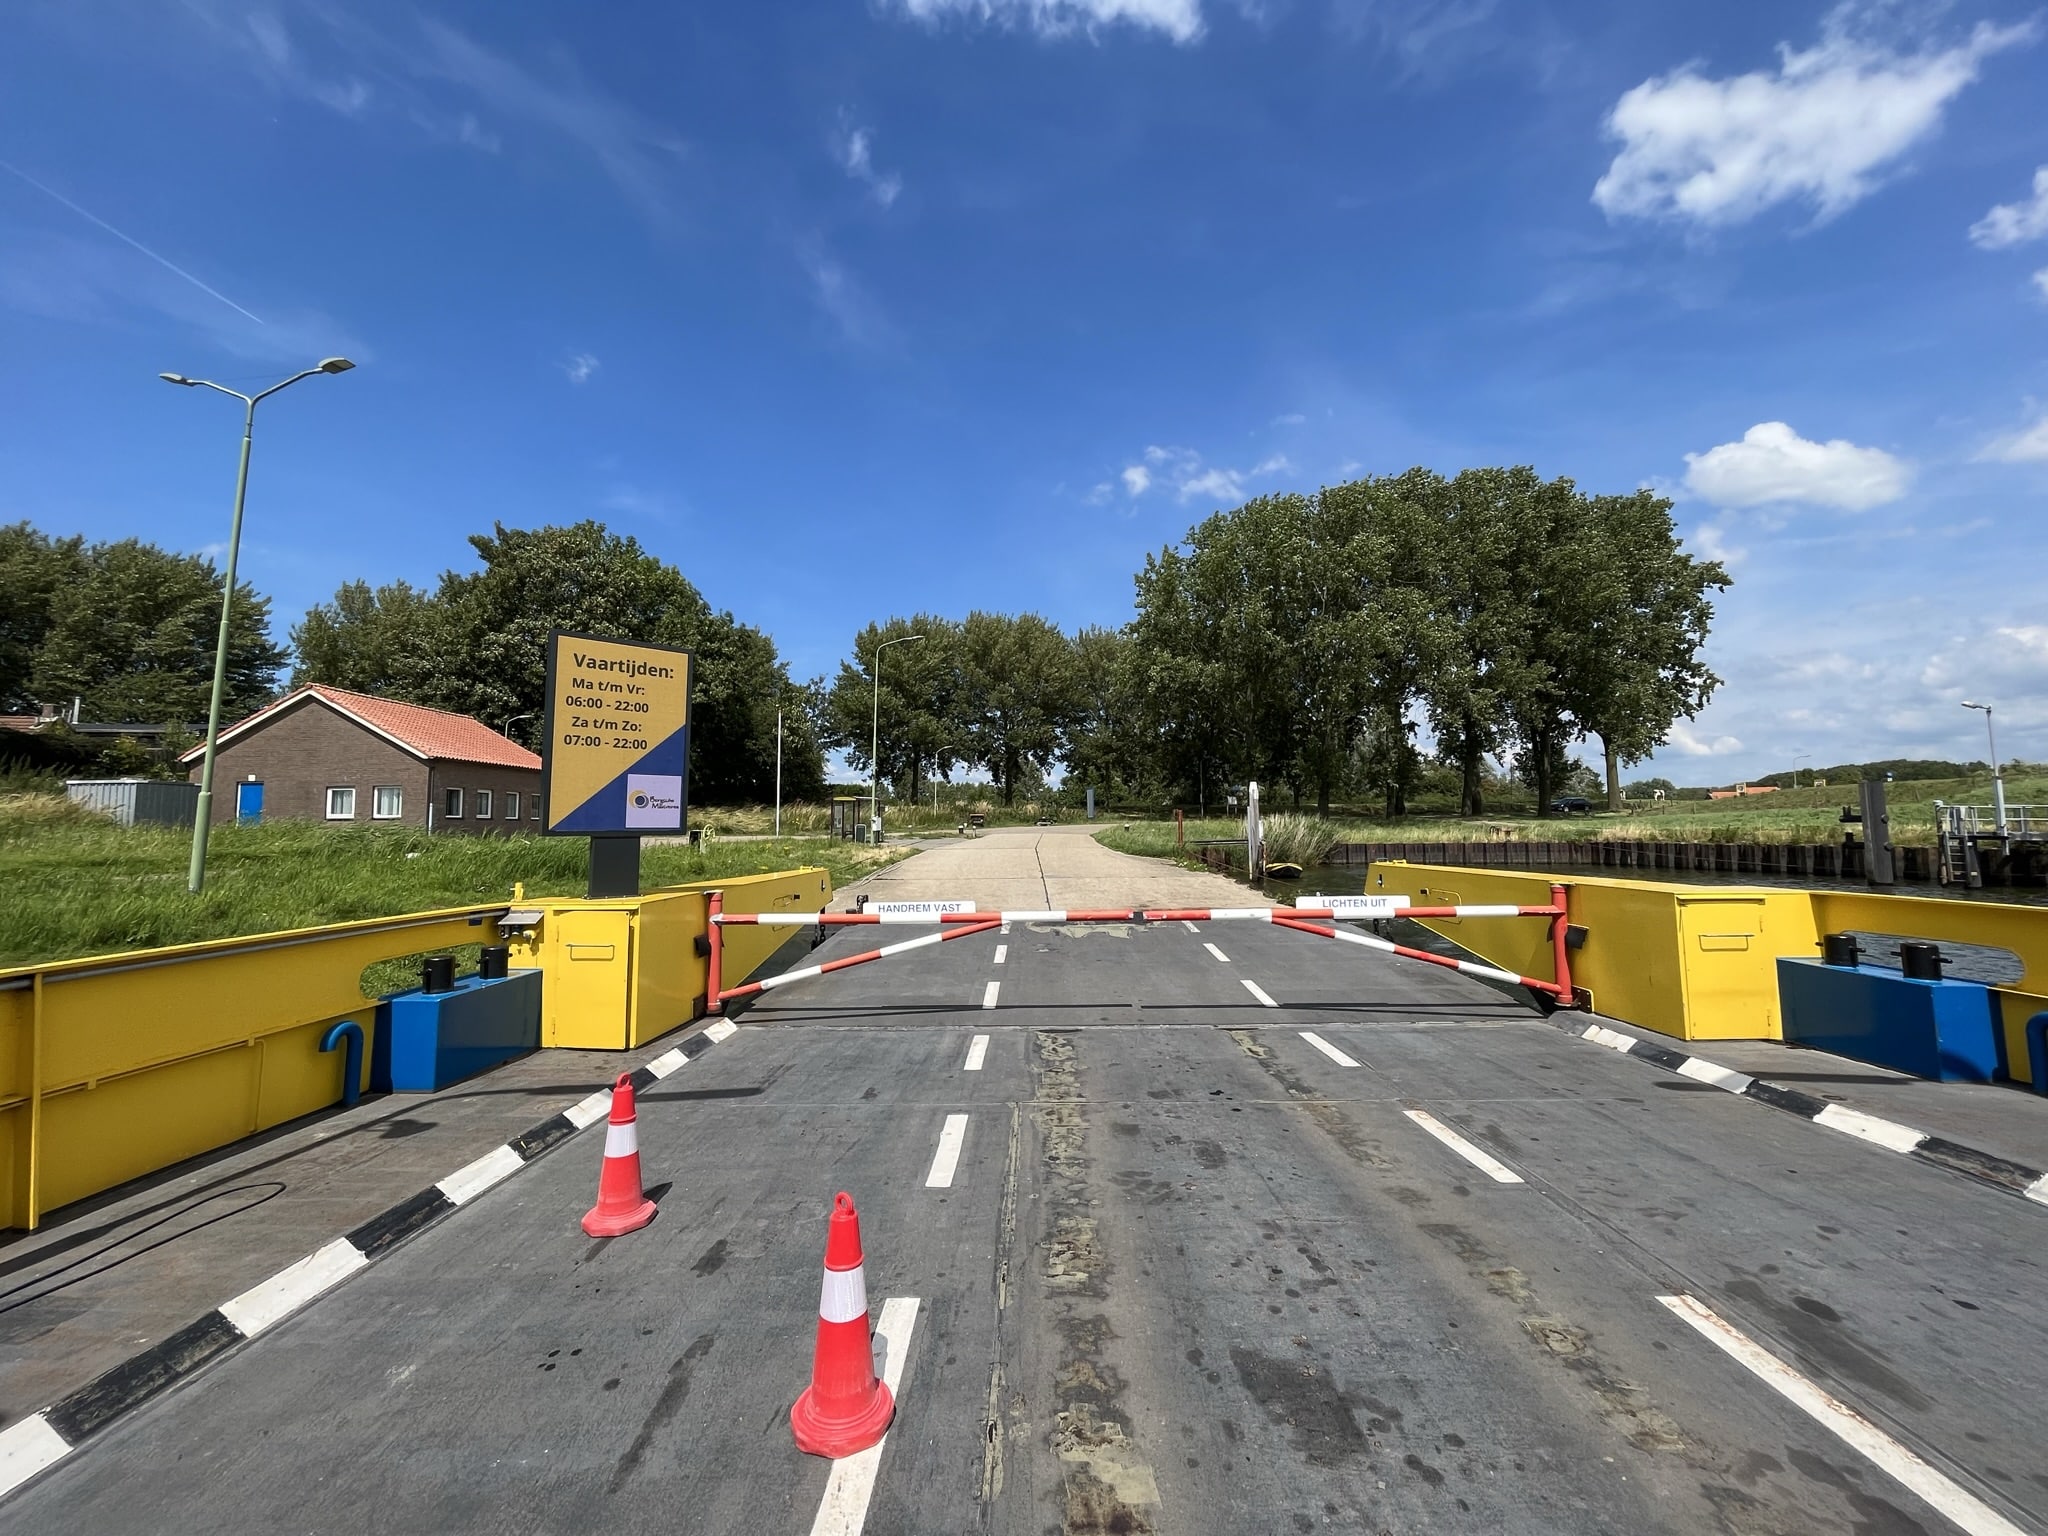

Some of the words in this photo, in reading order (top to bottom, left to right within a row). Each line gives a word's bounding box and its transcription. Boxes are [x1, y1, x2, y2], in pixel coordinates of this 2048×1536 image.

[573, 653, 674, 679] Vaartijden:
[572, 677, 594, 690] Ma
[598, 681, 623, 693] t/m
[626, 683, 645, 696] Vr:
[565, 695, 603, 709] 06:00
[614, 700, 649, 713] 22:00
[571, 716, 589, 728] Za
[593, 718, 618, 730] t/m
[621, 720, 642, 732] Zo:
[564, 734, 601, 747] 07:00
[613, 738, 648, 750] 22:00
[878, 904, 931, 913] HANDREM
[933, 903, 962, 912] VAST
[1322, 899, 1367, 908] LICHTEN
[1370, 898, 1387, 907] UIT
